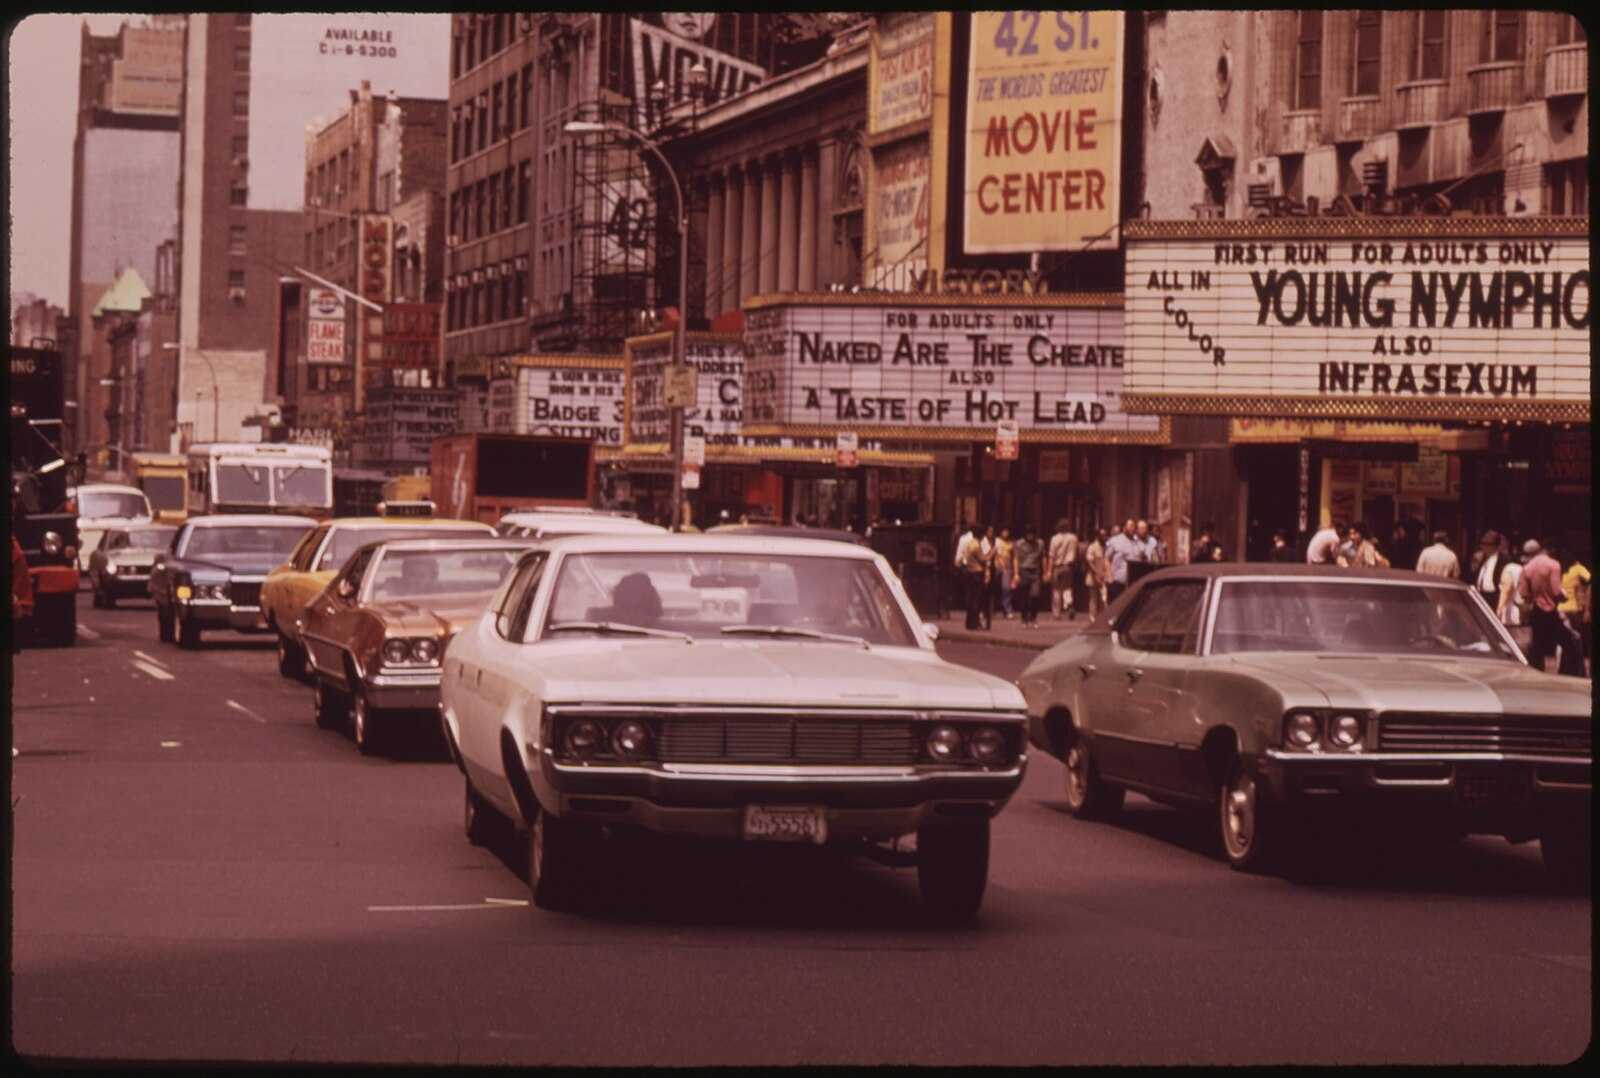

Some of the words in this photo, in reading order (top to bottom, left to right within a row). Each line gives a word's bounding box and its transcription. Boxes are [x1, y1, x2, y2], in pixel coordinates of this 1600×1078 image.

[325, 28, 392, 43] AVAILABLE
[977, 77, 997, 103] THE
[1049, 67, 1109, 96] GREATEST
[984, 109, 1097, 158] MOVIE
[978, 169, 1106, 215] CENTER
[607, 197, 649, 250] 42
[1214, 244, 1272, 265] FIRST
[1285, 244, 1328, 265] RUN
[1352, 243, 1393, 265] FOR
[1402, 243, 1488, 265] ADULTS
[1500, 243, 1554, 265] ONLY
[909, 266, 1046, 295] VICTORY
[1147, 270, 1184, 290] ALL
[1191, 270, 1211, 290] IN
[1250, 269, 1396, 328] YOUNG
[1410, 269, 1590, 330] NYMPHO
[310, 322, 343, 340] FLAME
[886, 313, 917, 329] FOR
[929, 313, 995, 329] ADULTS
[1013, 315, 1054, 330] ONLY
[1163, 296, 1226, 367] COLOR
[309, 341, 342, 359] STEAK
[892, 332, 950, 366] ARE
[966, 334, 1013, 366] THE
[1027, 335, 1124, 368] CHEATE
[1372, 335, 1432, 356] ALSO
[949, 370, 995, 386] ALSO
[1318, 360, 1537, 396] INFRASEXUM
[533, 398, 601, 422] BADGE
[829, 387, 906, 421] TASTE
[918, 398, 951, 422] OF
[964, 390, 1020, 423] HOT
